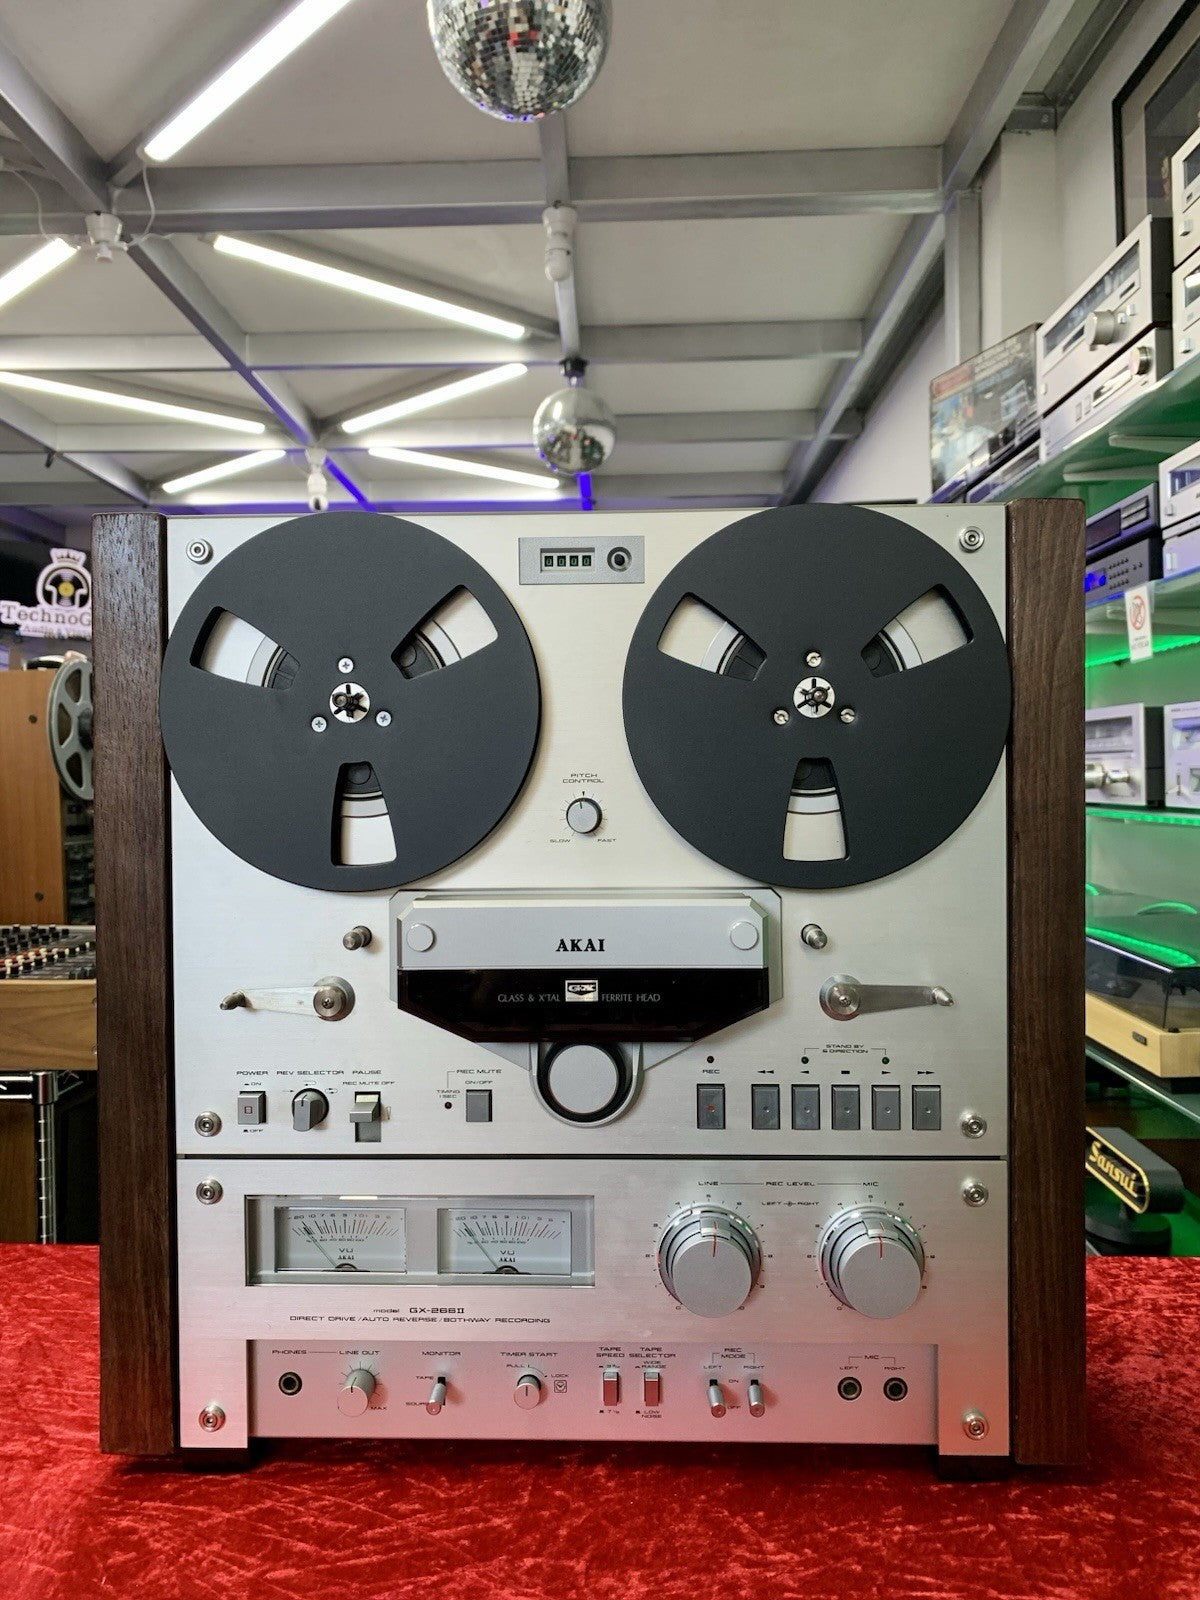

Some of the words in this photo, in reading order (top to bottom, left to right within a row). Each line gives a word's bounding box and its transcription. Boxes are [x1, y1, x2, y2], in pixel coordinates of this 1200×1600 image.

[556, 939, 605, 952] AKAI
[498, 994, 524, 1002] GLASS
[528, 994, 534, 1002] &
[602, 994, 632, 1002] FERRITE
[636, 994, 661, 1002] HEAD
[1089, 1141, 1138, 1197] Sansui
